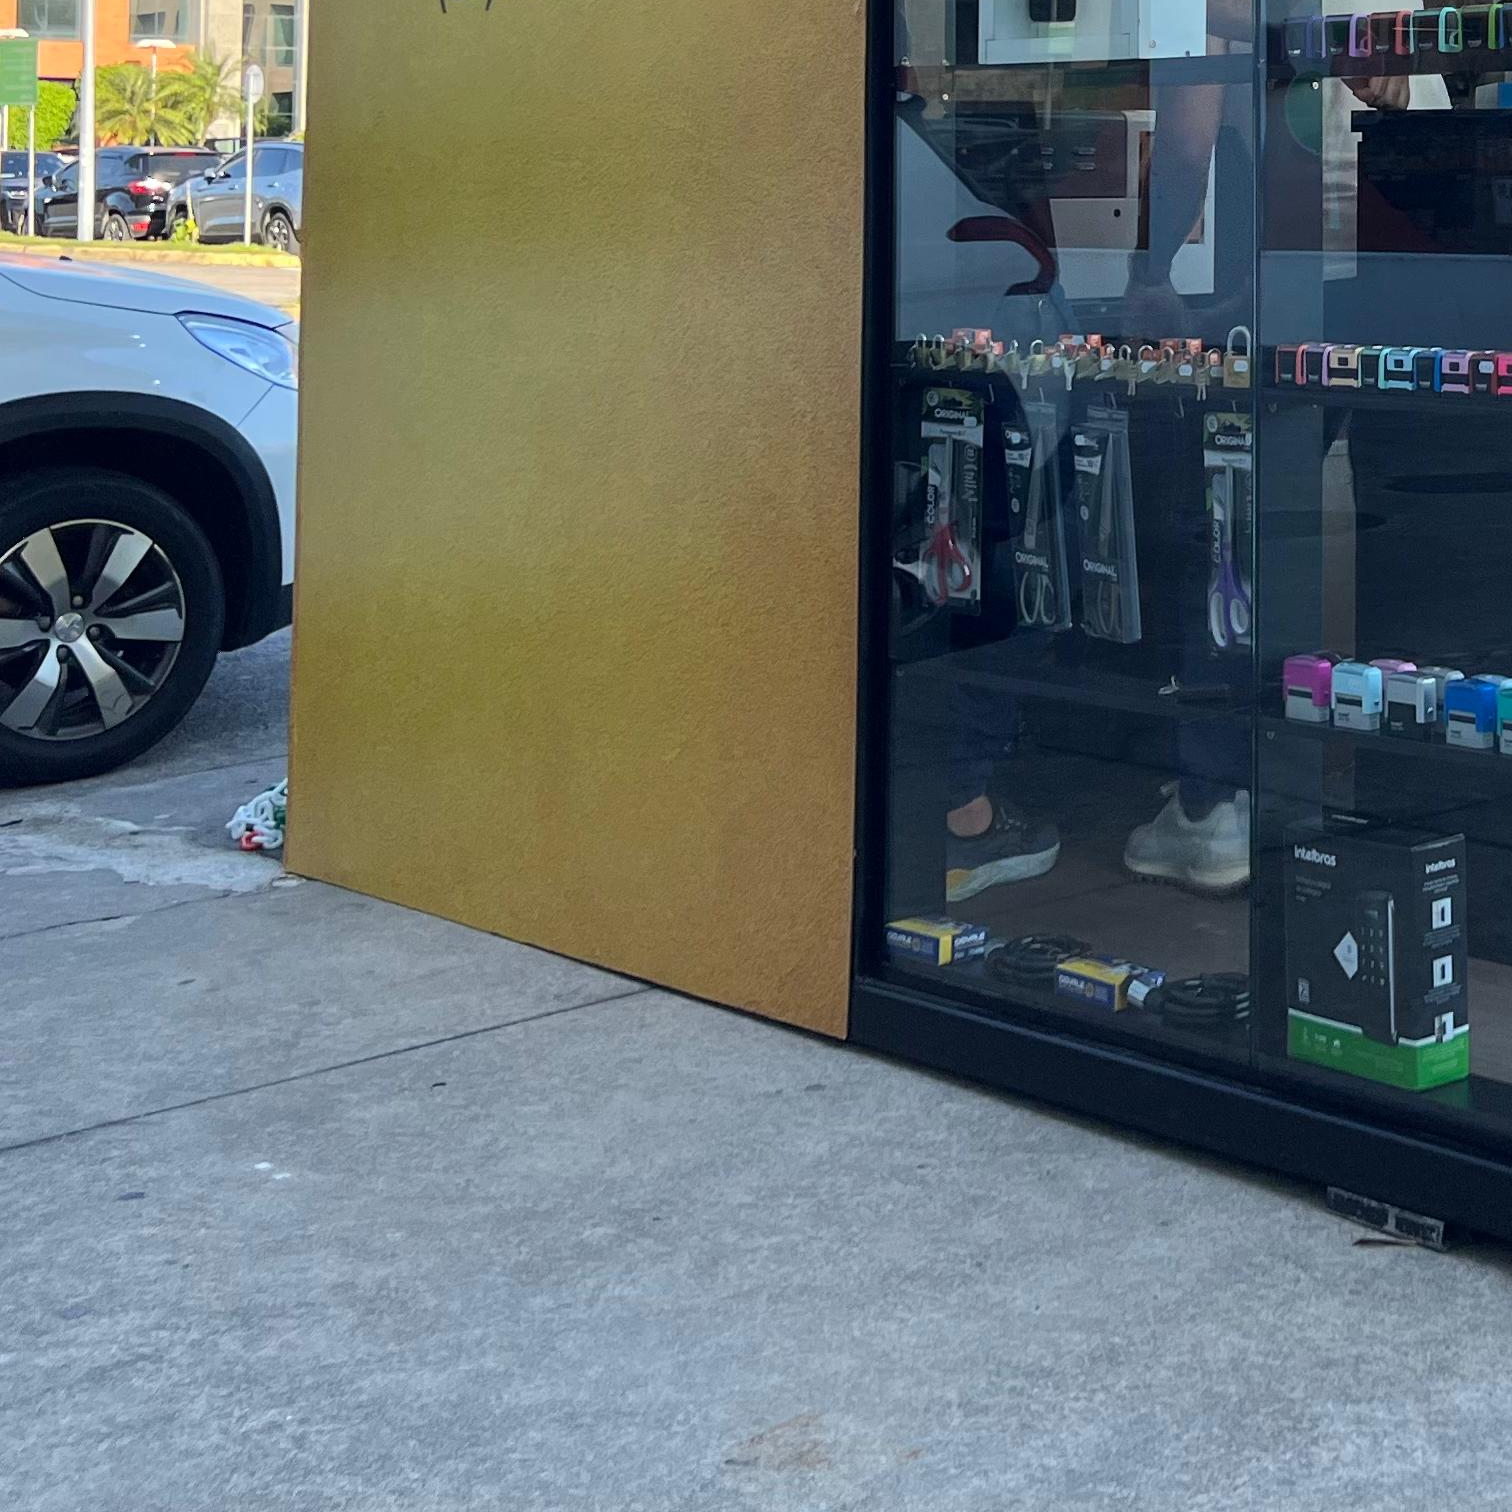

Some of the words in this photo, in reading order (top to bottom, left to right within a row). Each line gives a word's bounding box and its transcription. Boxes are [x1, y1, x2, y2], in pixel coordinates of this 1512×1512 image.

[1215, 434, 1252, 446] ORIGINA
[926, 484, 937, 524] COLOR
[1015, 551, 1048, 569] ORIGINAL
[1083, 559, 1117, 578] ORIGINAL
[1294, 845, 1337, 867] intelbras
